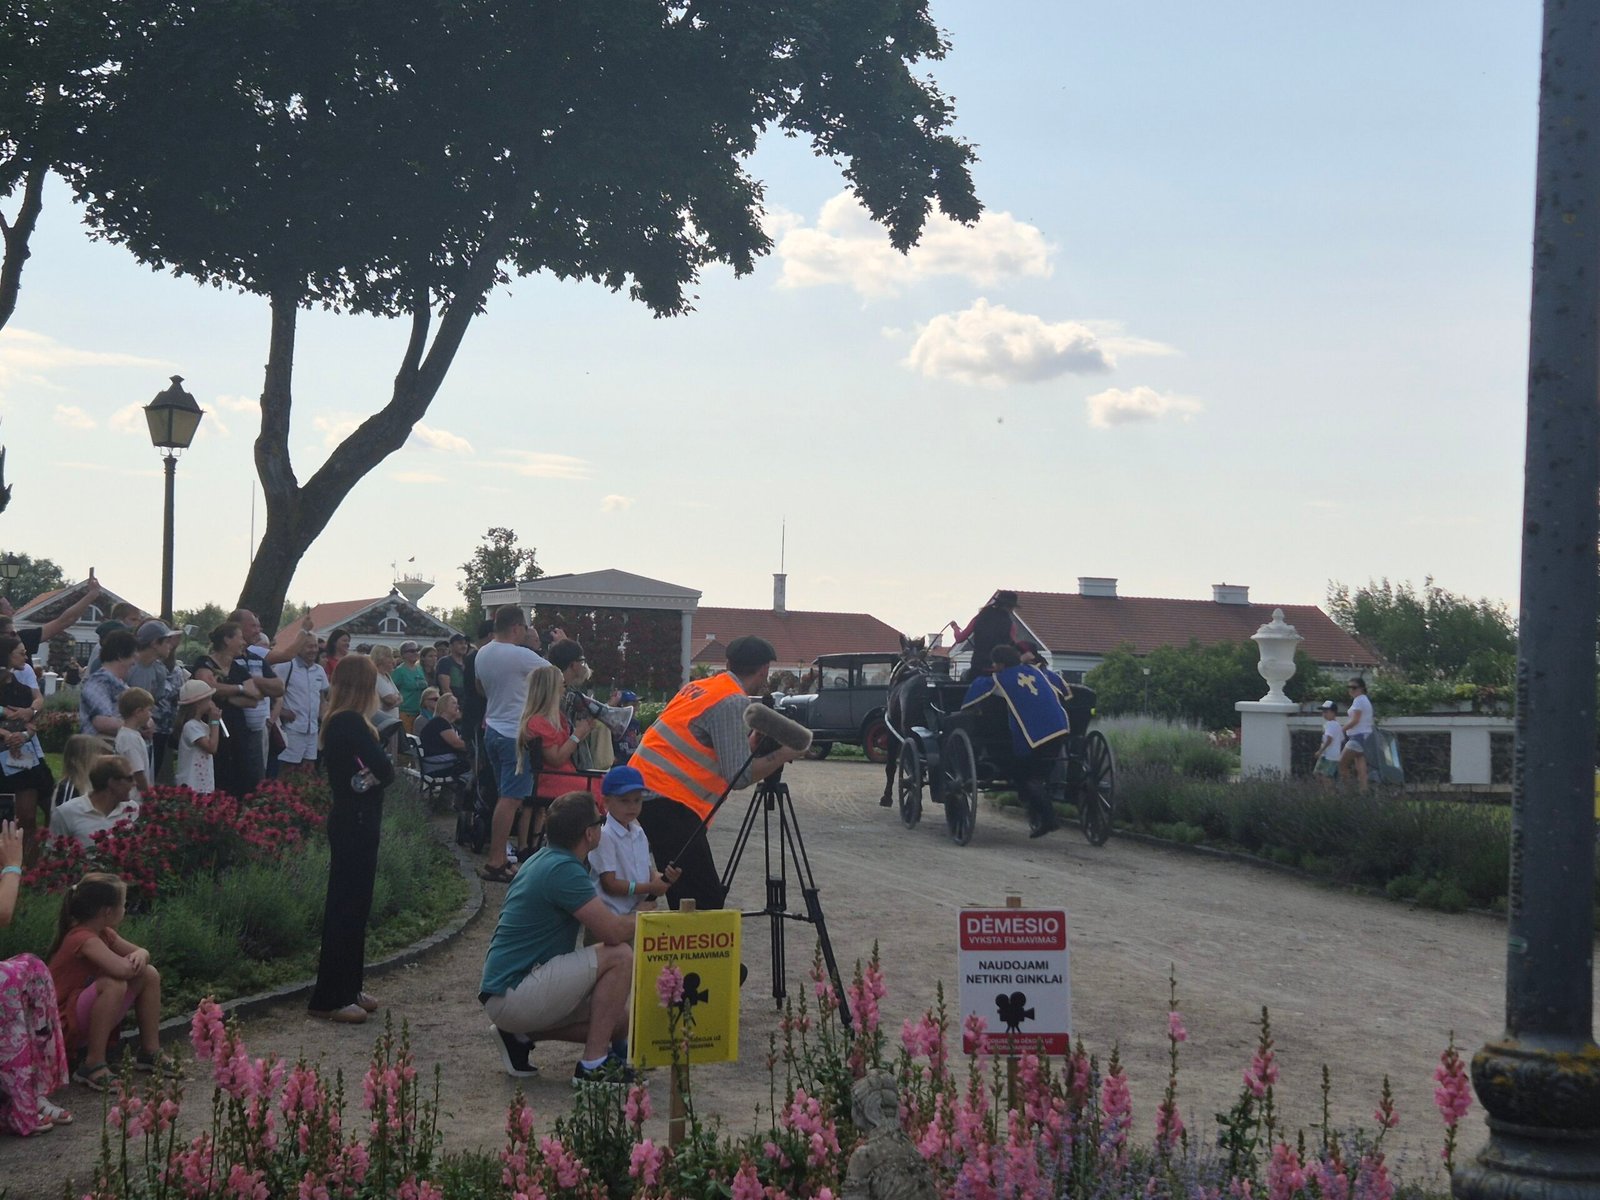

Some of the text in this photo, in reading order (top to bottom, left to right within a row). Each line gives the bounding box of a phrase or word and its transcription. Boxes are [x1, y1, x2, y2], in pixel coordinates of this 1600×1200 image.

[966, 915, 1059, 934] DĖMESIO
[643, 932, 735, 952] DĖMESIO!
[969, 936, 1057, 944] VYKSTA FILMAVIMAS
[647, 951, 730, 962] VYKSTA FILMAVIMAS
[978, 960, 1049, 970] NAUDOJAMI
[966, 974, 1063, 984] NETIKRI GINKLAI
